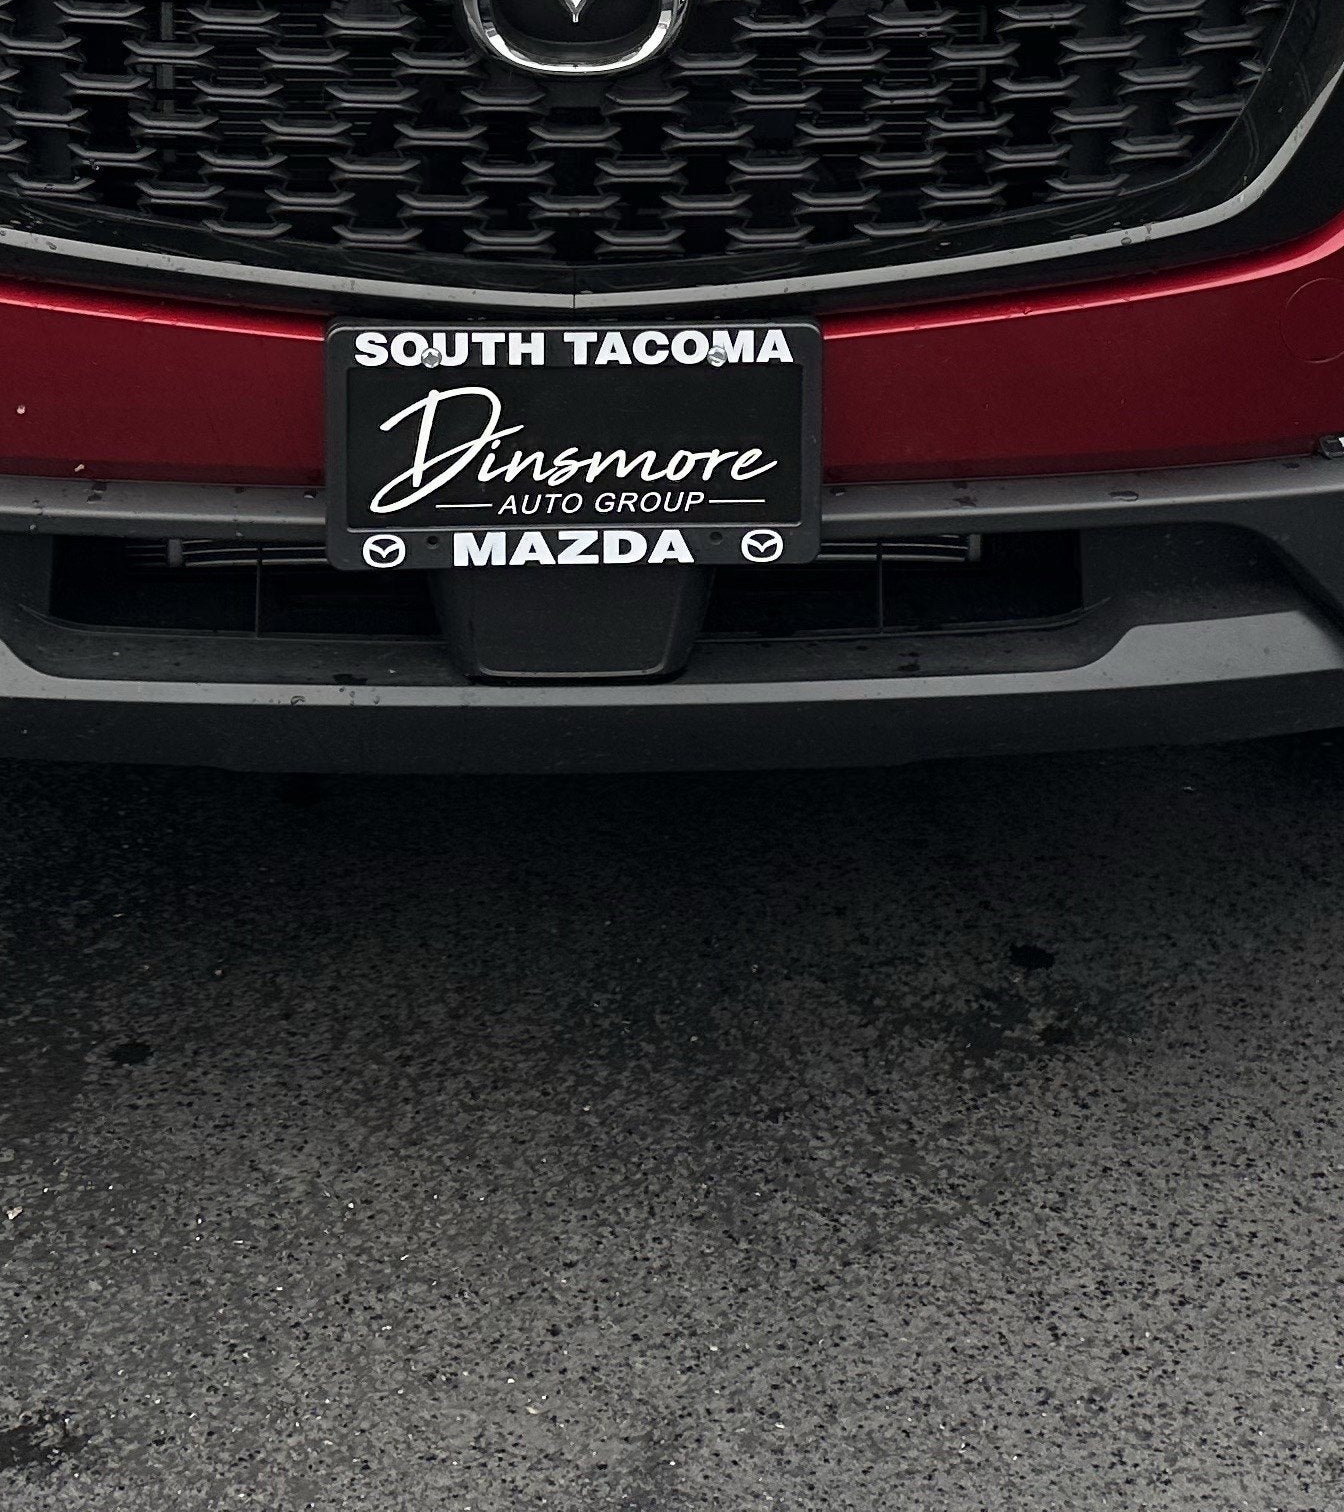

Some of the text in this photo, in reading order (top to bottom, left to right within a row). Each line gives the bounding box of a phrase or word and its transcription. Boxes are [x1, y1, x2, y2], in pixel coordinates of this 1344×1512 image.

[355, 329, 794, 366] SOUTH TACOMA
[369, 386, 778, 514] Dinsmore
[498, 491, 705, 515] AUTO GROUP
[453, 529, 695, 567] MAZDA
